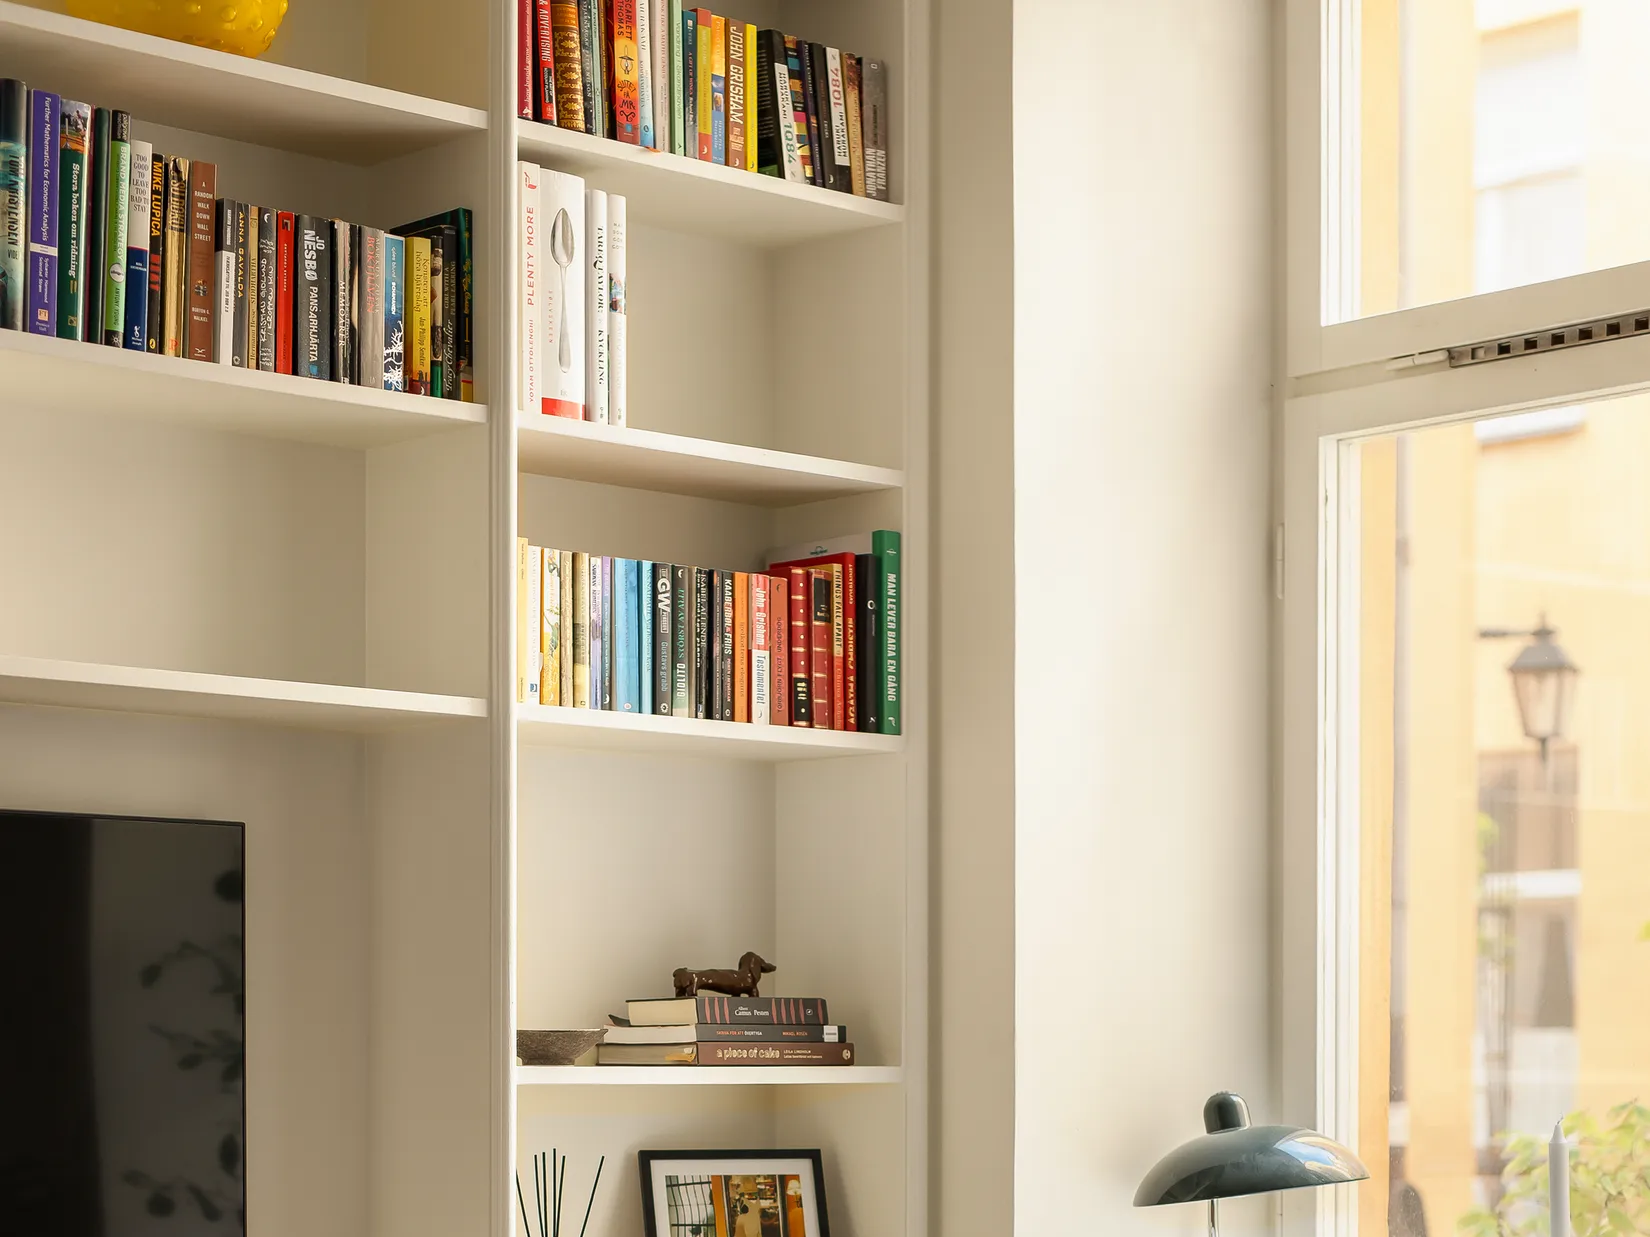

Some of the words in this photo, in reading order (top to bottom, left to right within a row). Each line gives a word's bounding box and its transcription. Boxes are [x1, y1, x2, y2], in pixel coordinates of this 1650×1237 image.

[540, 9, 551, 62] ADVERTISING
[730, 27, 743, 60] JOHN
[730, 64, 744, 124] GRISHAM
[778, 72, 787, 119] MURAKAMI
[782, 73, 790, 105] HARUKI
[832, 68, 844, 108] 1Q84
[619, 100, 636, 110] MR
[619, 110, 636, 122] Y
[783, 122, 797, 164] 1Q84
[839, 112, 848, 158] MURAKAMI
[134, 163, 148, 171] GOOD
[136, 154, 147, 162] TOO
[866, 148, 877, 196] JONATHAN
[877, 150, 886, 190] FRANZEN
[72, 163, 80, 191] Stora
[132, 179, 148, 188] LEAVE
[152, 162, 162, 191] MIKE
[42, 180, 50, 212] Economic
[118, 181, 126, 210] MEDIA
[131, 194, 142, 203] BAD
[134, 204, 146, 212] STAY
[197, 202, 210, 210] WALK
[41, 213, 49, 241] Analysis
[71, 223, 77, 237] om
[151, 194, 162, 236] LUPICA
[526, 206, 534, 246] MORE
[117, 214, 125, 261] STRATEGY
[194, 233, 211, 242] STREET
[316, 236, 325, 250] JO
[68, 240, 78, 278] ridning
[304, 229, 318, 280] NESBØ
[366, 236, 376, 314] BOKTJUVEN
[266, 288, 274, 329] KROPPEN
[414, 274, 422, 312] hjärtslag
[259, 301, 267, 342] KRISTIAN
[309, 286, 320, 362] PANSARHJÄRTA
[338, 280, 346, 346] MEMOARER
[418, 328, 426, 346] Philipp
[443, 319, 453, 366] Chevalier
[444, 364, 455, 391] Tracy
[658, 578, 670, 612] GW
[756, 588, 766, 608] John
[887, 573, 896, 595] MAN
[678, 611, 684, 622] AV
[724, 579, 732, 628] KAABERBØL
[887, 598, 896, 628] LEVER
[724, 633, 732, 654] FRIIS
[756, 612, 766, 645] Grisham
[887, 631, 896, 657] BARA
[660, 671, 668, 692] grabb
[677, 663, 685, 697] GIOLITO
[756, 655, 766, 704] Testamentet
[887, 660, 896, 672] EN
[887, 675, 897, 701] GÅNG
[716, 1049, 722, 1058] a
[723, 1047, 748, 1060] piece
[748, 1047, 758, 1058] of
[759, 1047, 780, 1058] cake
